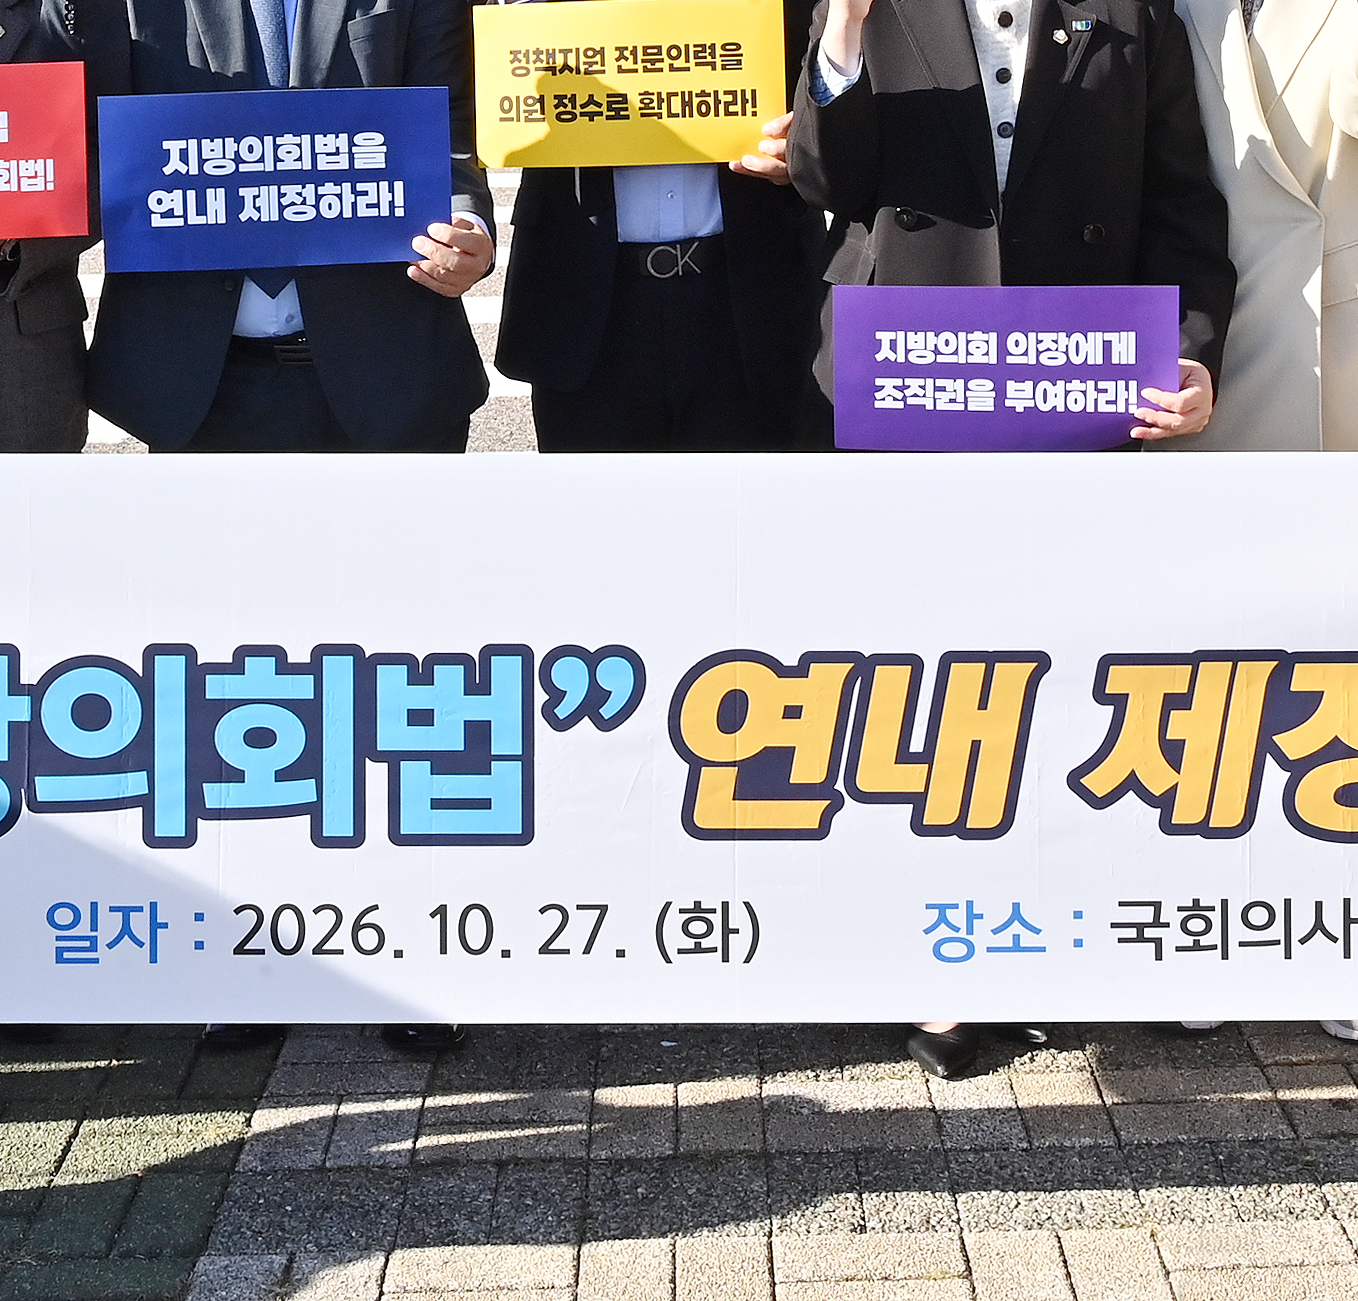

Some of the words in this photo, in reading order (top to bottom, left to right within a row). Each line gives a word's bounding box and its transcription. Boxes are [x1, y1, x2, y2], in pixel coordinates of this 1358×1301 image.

[509, 47, 606, 77] 정책지원
[614, 42, 744, 74] 전문인력을
[499, 94, 546, 123] 의원
[553, 92, 631, 124] 정수로
[638, 89, 758, 120] 확대하라!
[161, 131, 387, 176] 지방의회법을
[147, 187, 227, 228] 연내
[238, 180, 405, 222] 제정하라!
[646, 241, 701, 278] CK
[874, 330, 998, 365] 지방의회
[1005, 331, 1136, 367] 의장에게
[874, 377, 996, 412] 조직권을
[1004, 379, 1138, 414] 부여하라!
[667, 649, 1052, 841] 연내
[44, 900, 169, 965] 일자
[232, 903, 404, 959] 2026.
[429, 903, 511, 959] 10.
[537, 903, 627, 959] 27.
[654, 900, 761, 965] (화)
[922, 899, 1048, 964] 장소
